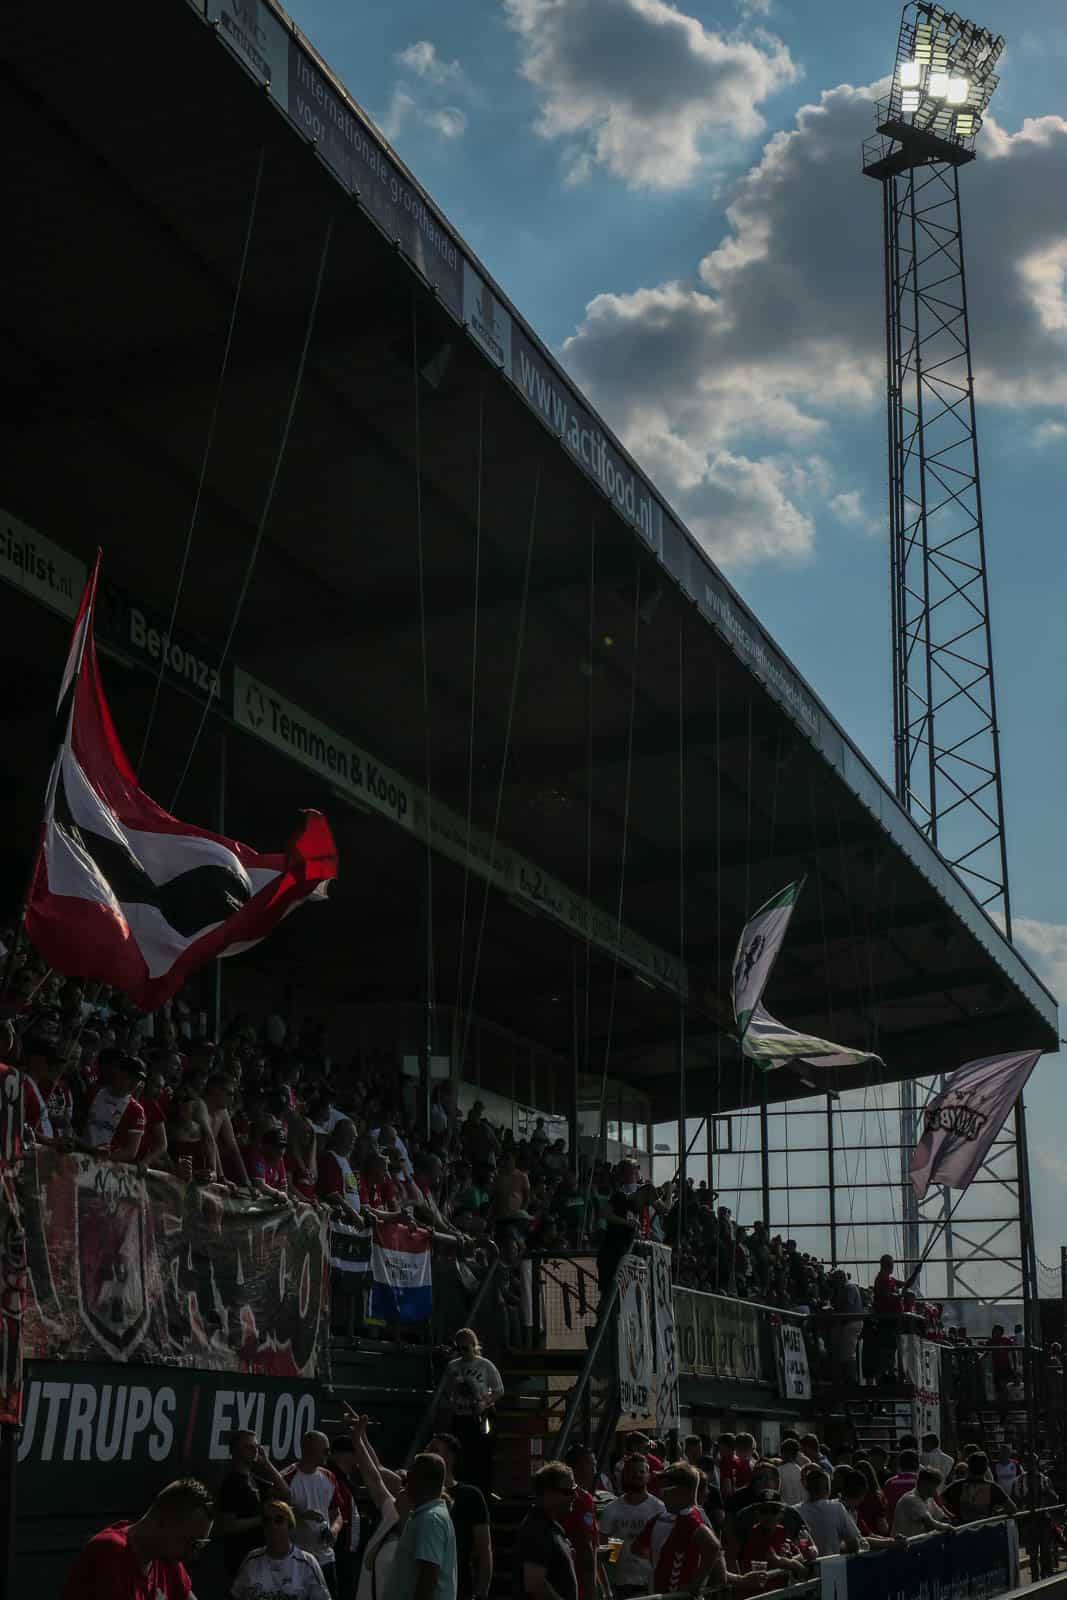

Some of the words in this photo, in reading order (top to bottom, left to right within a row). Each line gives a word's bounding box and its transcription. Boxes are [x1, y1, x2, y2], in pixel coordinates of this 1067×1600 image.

[296, 52, 388, 185] Internationale
[389, 177, 458, 272] groothandel
[519, 350, 656, 541] www.actifood.nl
[130, 608, 221, 701] Betonza
[269, 698, 348, 777] Temmen
[350, 754, 362, 786] &
[366, 762, 408, 818] Koop
